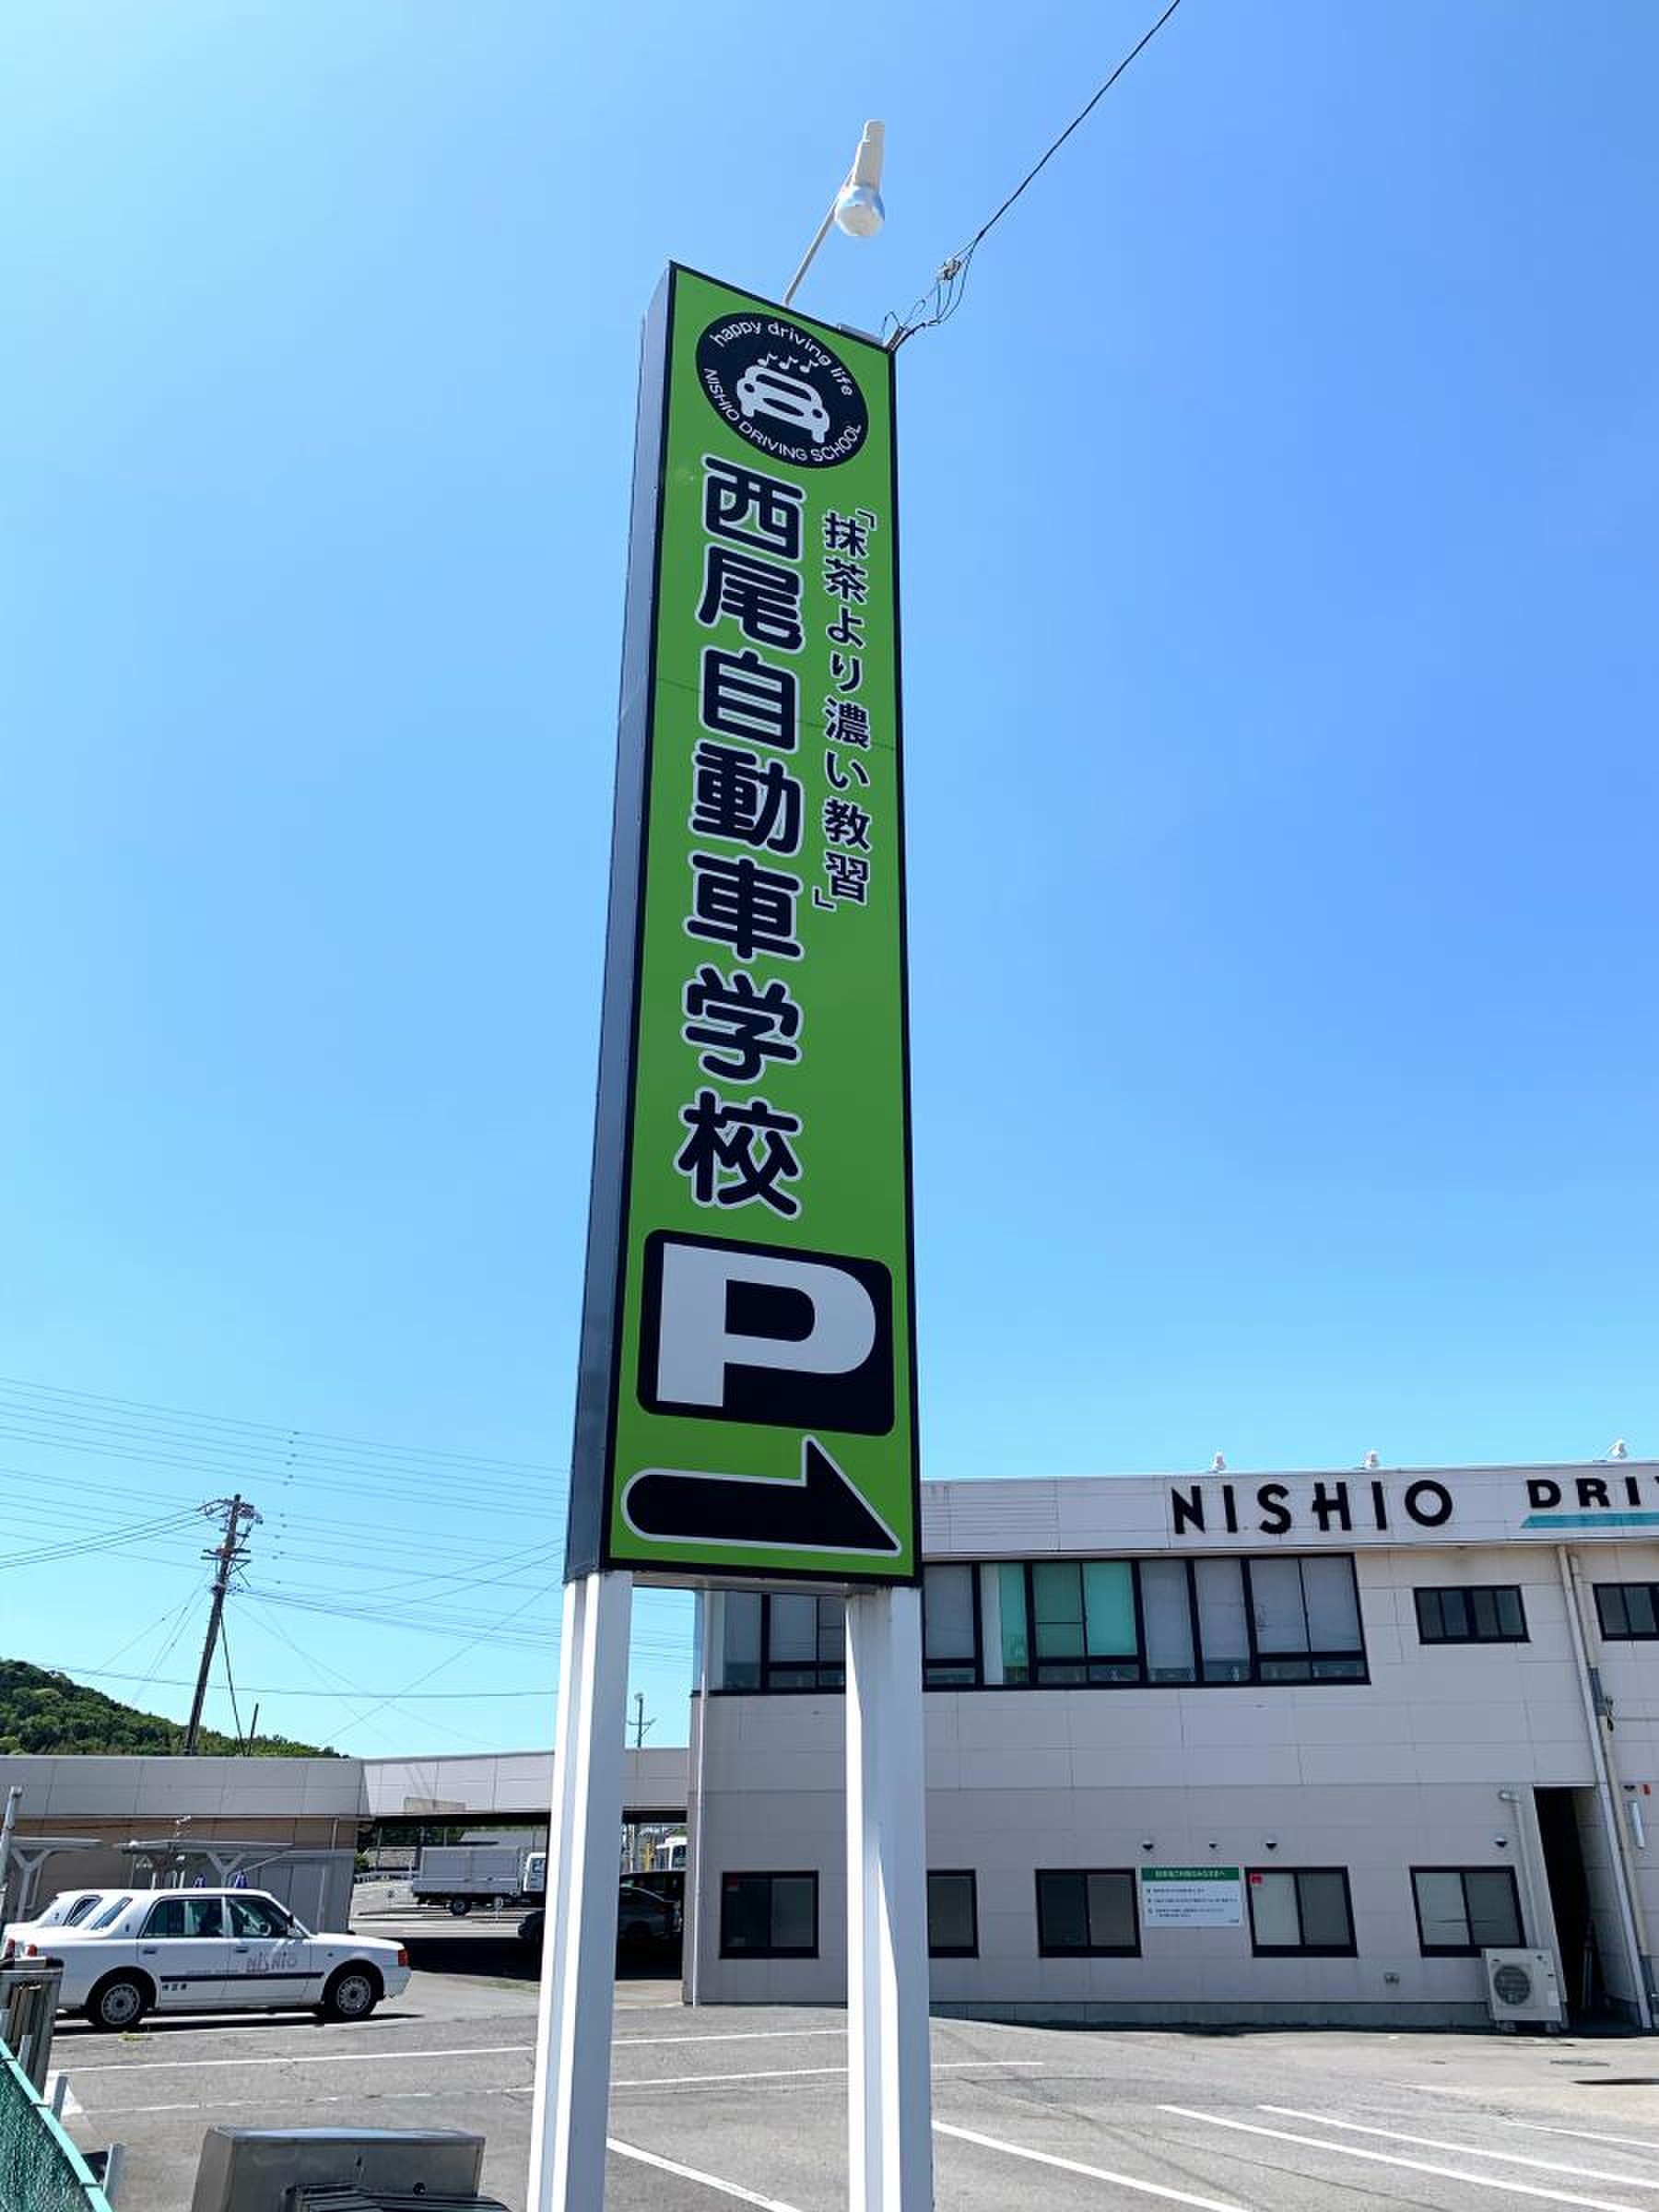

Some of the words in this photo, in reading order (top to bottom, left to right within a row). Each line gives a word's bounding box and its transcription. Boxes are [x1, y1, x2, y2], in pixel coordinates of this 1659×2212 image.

[703, 368, 741, 421] NISHIO
[738, 421, 808, 461] DRIVING
[810, 424, 862, 462] SCHOOL
[710, 321, 762, 347] happy
[767, 323, 831, 367] driving
[830, 367, 853, 396] life
[813, 508, 877, 911] 「抹茶より濃い教習」
[677, 453, 807, 1218] 西尾自動車学校
[656, 1242, 876, 1407] P
[1171, 1479, 1453, 1534] NISHIO
[1526, 1477, 1659, 1509] DRI
